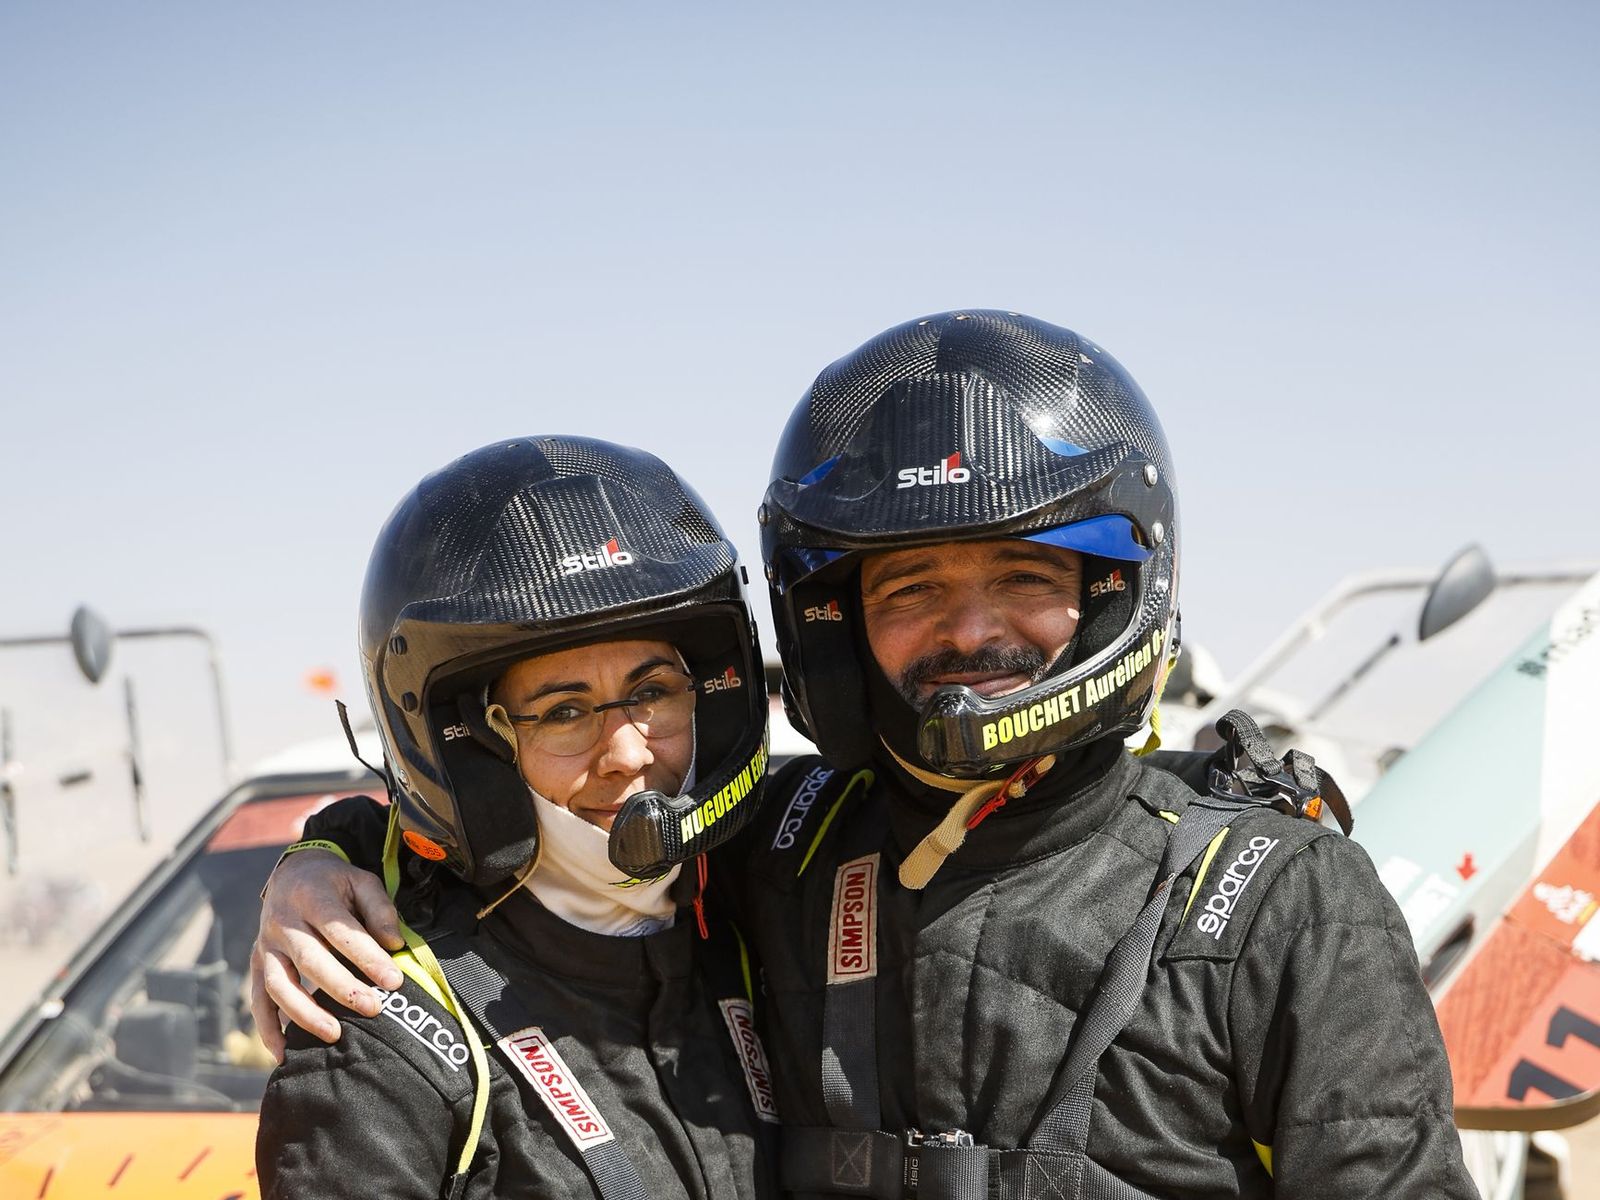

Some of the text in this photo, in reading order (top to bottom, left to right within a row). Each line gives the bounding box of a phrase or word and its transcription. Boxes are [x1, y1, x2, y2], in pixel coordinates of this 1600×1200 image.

[897, 454, 971, 489] Stilo
[562, 539, 634, 576] Stilo
[1090, 570, 1126, 597] Stilo
[804, 601, 843, 622] Stilo
[704, 666, 742, 694] Stilo
[982, 685, 1081, 751] BOUCHET
[1085, 643, 1152, 707] Aurélien
[680, 765, 754, 844] HUGUENIN
[776, 766, 835, 850] sparco
[840, 872, 867, 968] SIMPSON
[1197, 836, 1277, 938] sparco
[520, 1044, 600, 1134] SIMPSON
[735, 1013, 775, 1112] SIMPSON
